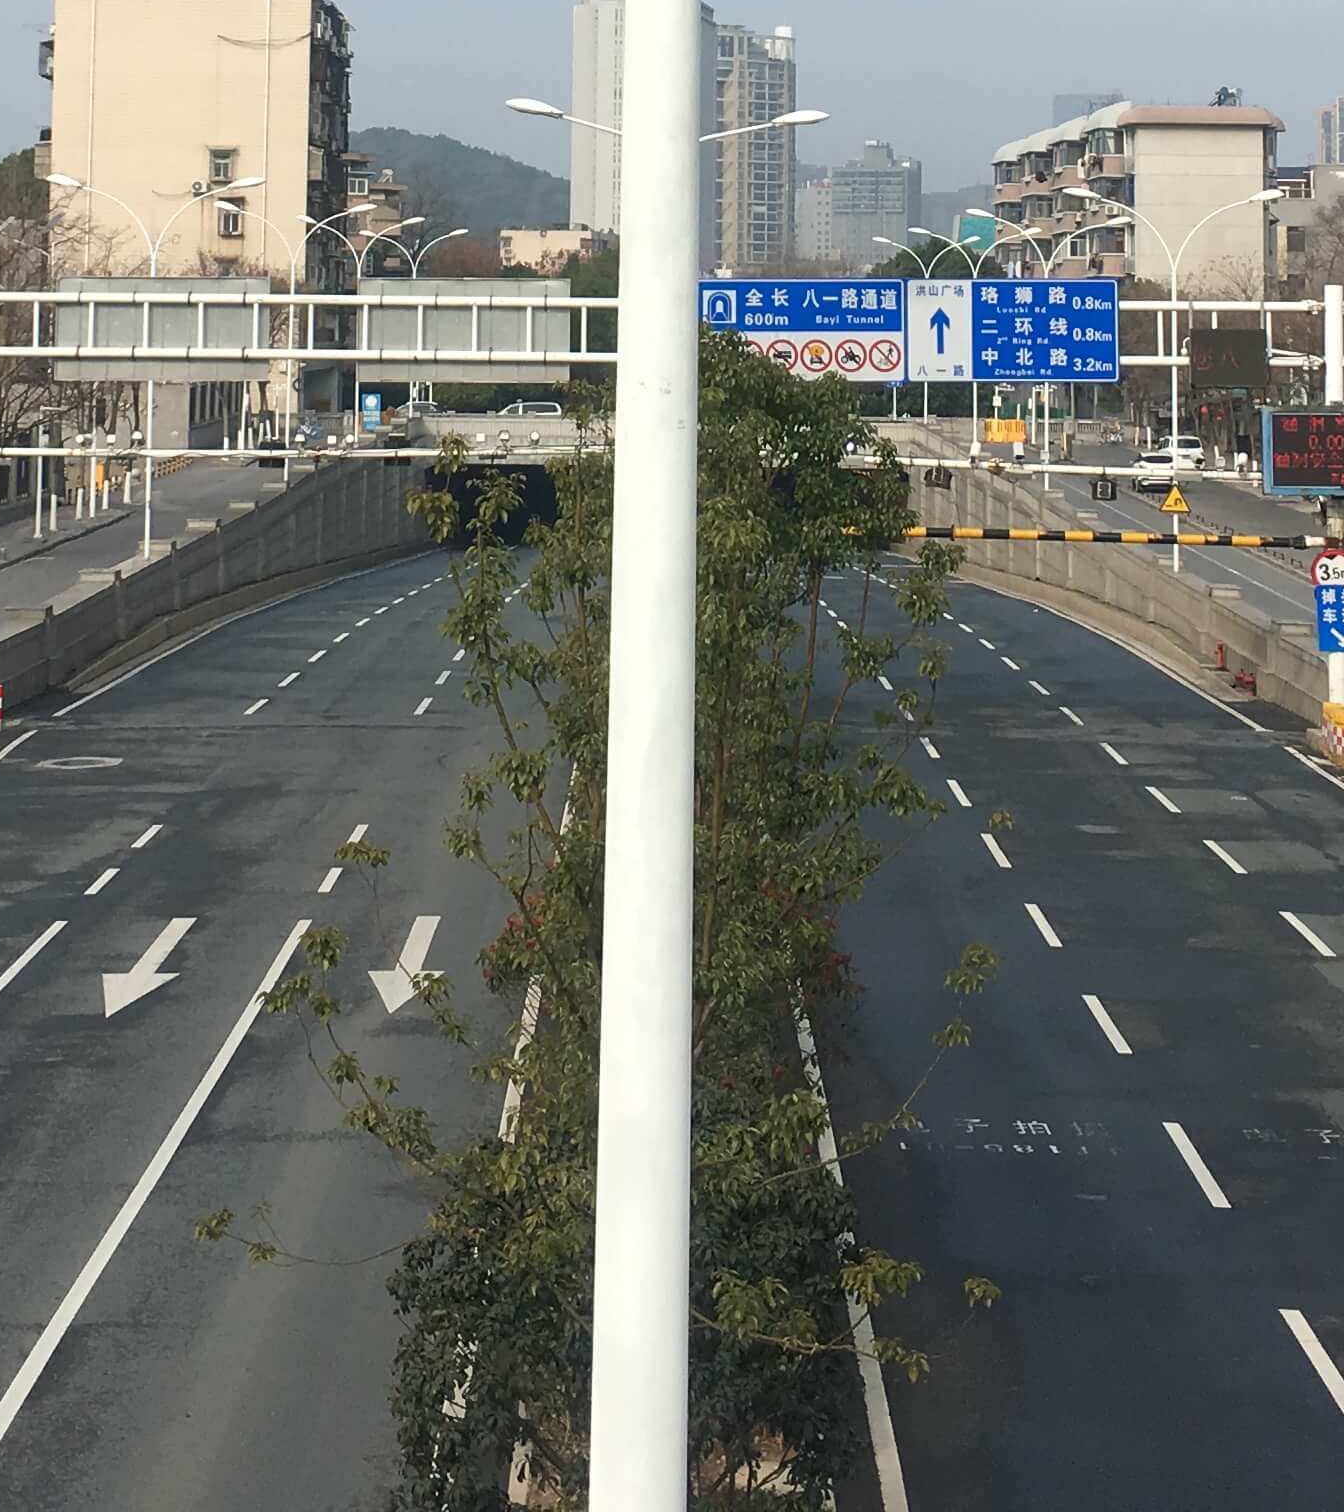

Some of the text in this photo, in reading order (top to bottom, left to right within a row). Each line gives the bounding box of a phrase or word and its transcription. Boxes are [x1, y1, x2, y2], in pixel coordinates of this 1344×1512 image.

[915, 285, 965, 297] 洪山广场
[981, 286, 1067, 304] 珞狮路
[745, 288, 897, 310] 全长 八一路通道
[1072, 296, 1112, 310] 0.8Km
[744, 313, 789, 326] 600m
[815, 315, 884, 326] Bayi Tunnel
[981, 317, 1068, 336] 二环线
[1012, 337, 1032, 345] Ring
[1072, 328, 1112, 342] 0.8Km
[981, 347, 1068, 366] 中北路
[917, 365, 964, 377] 八一路
[1072, 358, 1113, 372] 3.2Km
